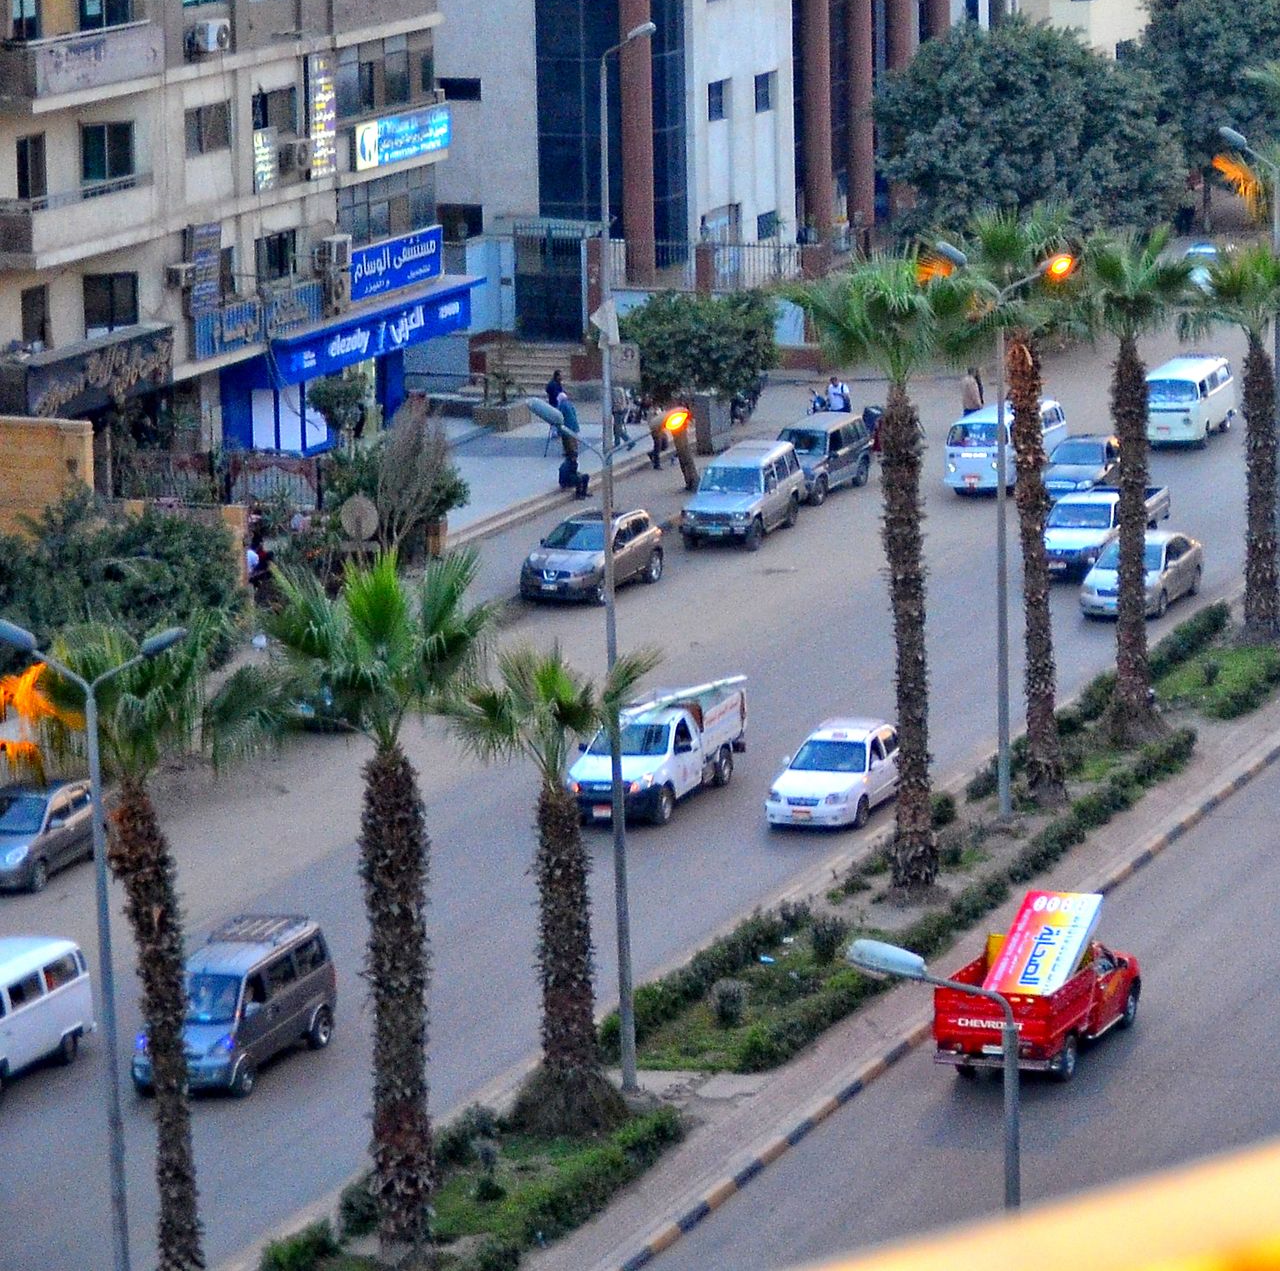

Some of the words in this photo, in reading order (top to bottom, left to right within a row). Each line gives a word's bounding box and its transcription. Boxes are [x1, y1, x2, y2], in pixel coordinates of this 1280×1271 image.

[354, 245, 391, 284] الوسام
[393, 235, 437, 270] مستشفى
[1019, 925, 1063, 986] الصحابة
[957, 1017, 1025, 1031] CHEVROT
